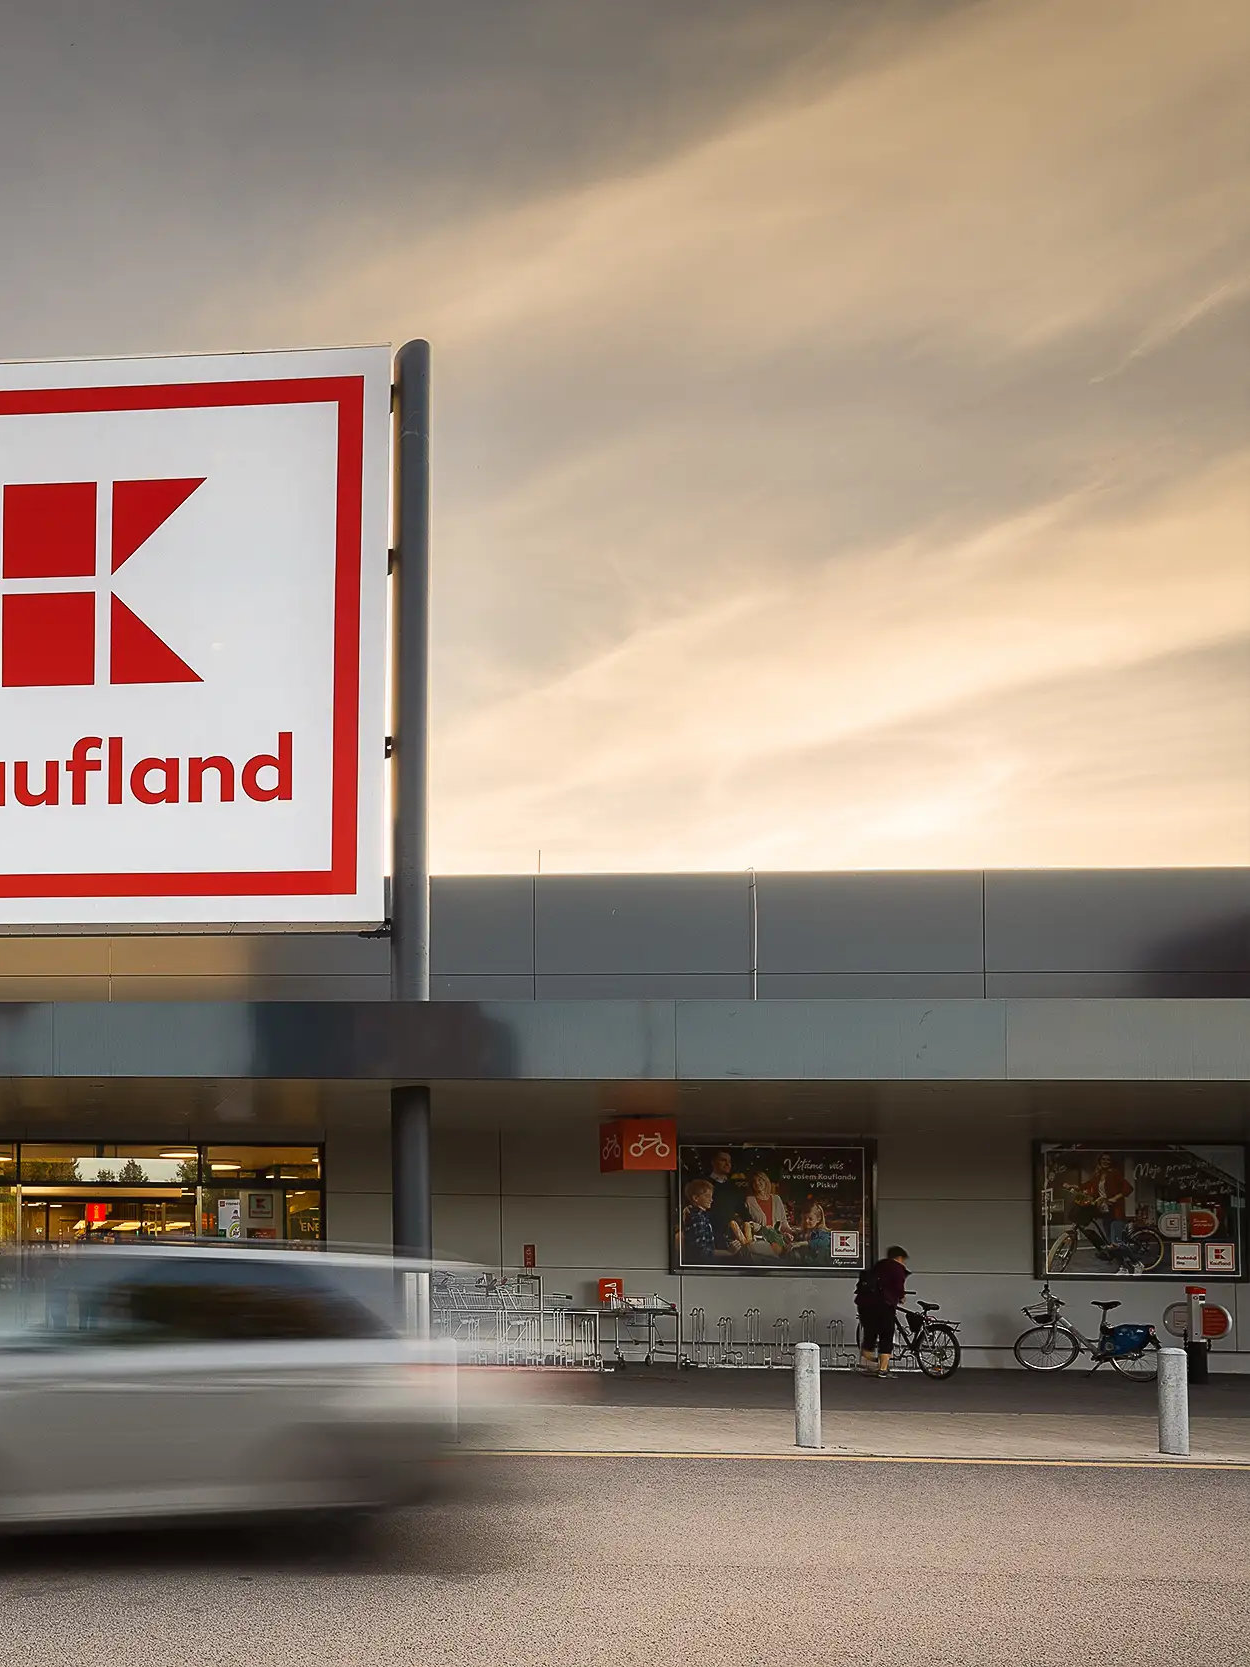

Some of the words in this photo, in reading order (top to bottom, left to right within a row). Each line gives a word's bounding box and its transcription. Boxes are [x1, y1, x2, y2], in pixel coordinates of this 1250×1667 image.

[2, 477, 207, 687] K
[783, 1156, 825, 1172] Vítáme
[829, 1160, 845, 1170] vás
[1133, 1162, 1162, 1181] Moje
